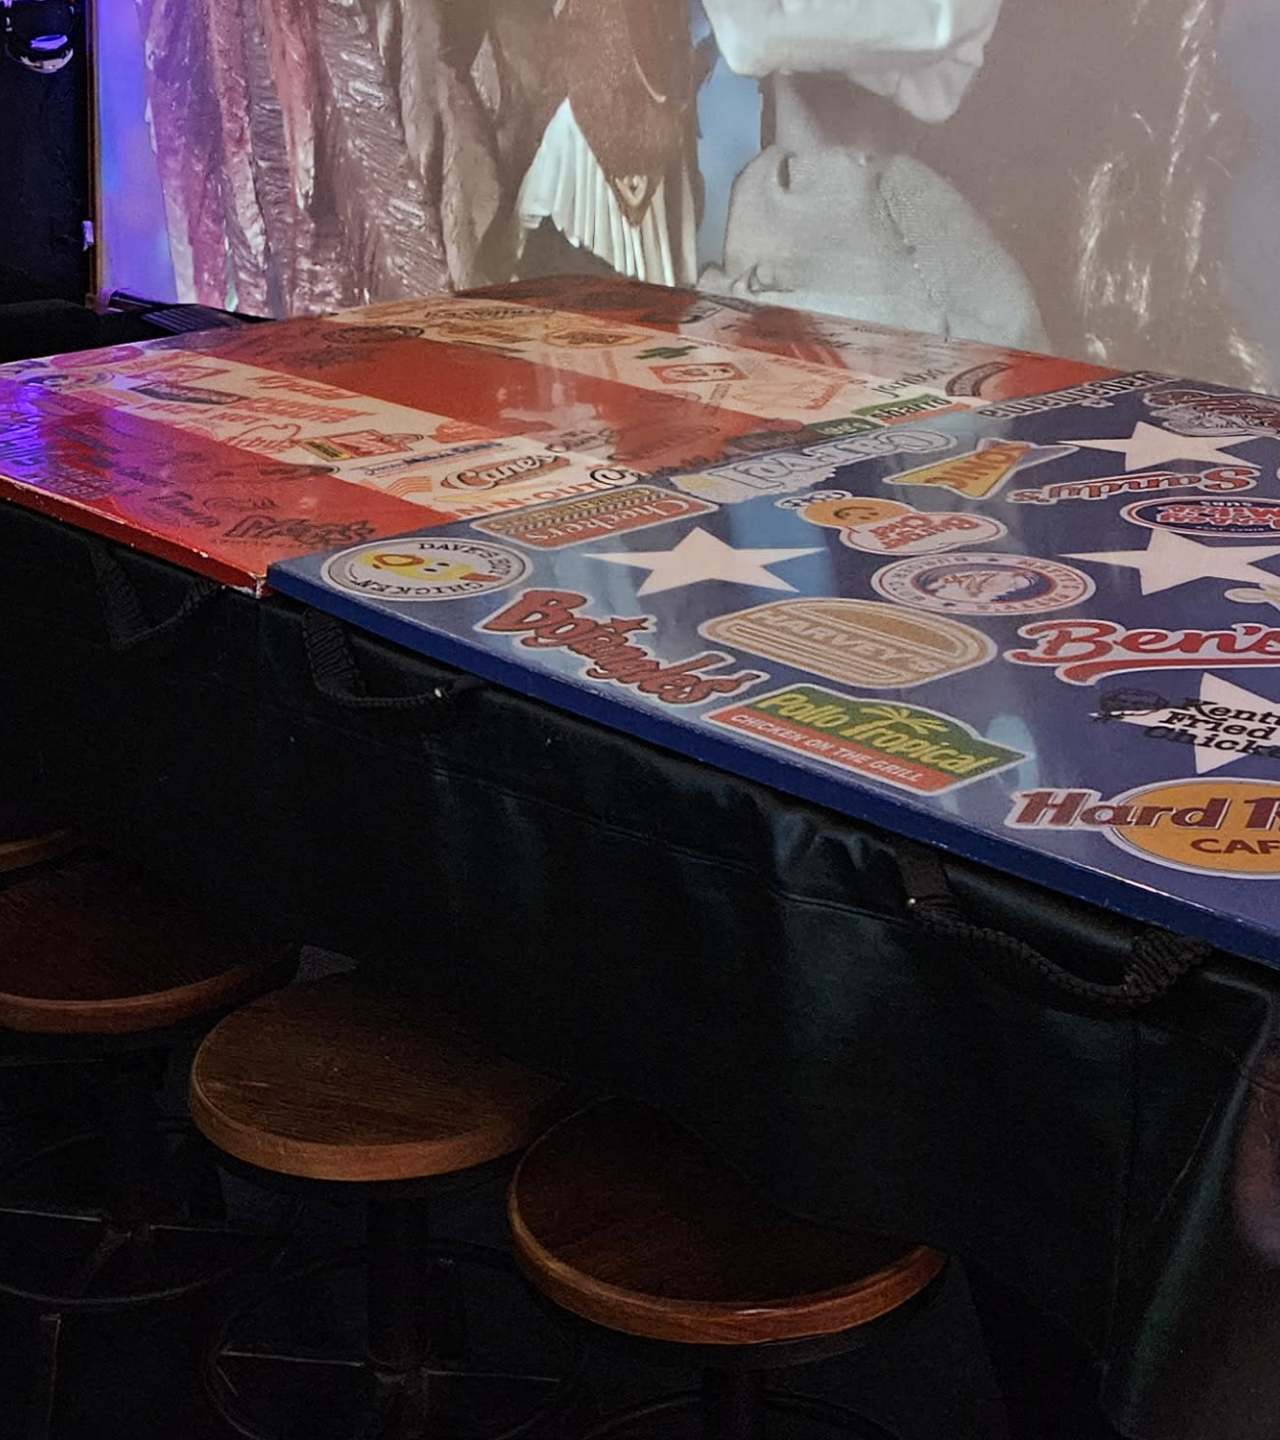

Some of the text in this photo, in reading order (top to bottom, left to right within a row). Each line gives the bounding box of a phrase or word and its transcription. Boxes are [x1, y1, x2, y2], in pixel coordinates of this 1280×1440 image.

[1012, 467, 1253, 502] Sandy's
[524, 498, 691, 541] Checkers
[753, 612, 944, 673] HARVEY'S
[758, 694, 1000, 775] Pollo Tropical
[1158, 710, 1273, 742] Fried
[731, 714, 925, 783] CHICKEN ON THE GRILL
[1018, 790, 1228, 828] Hard
